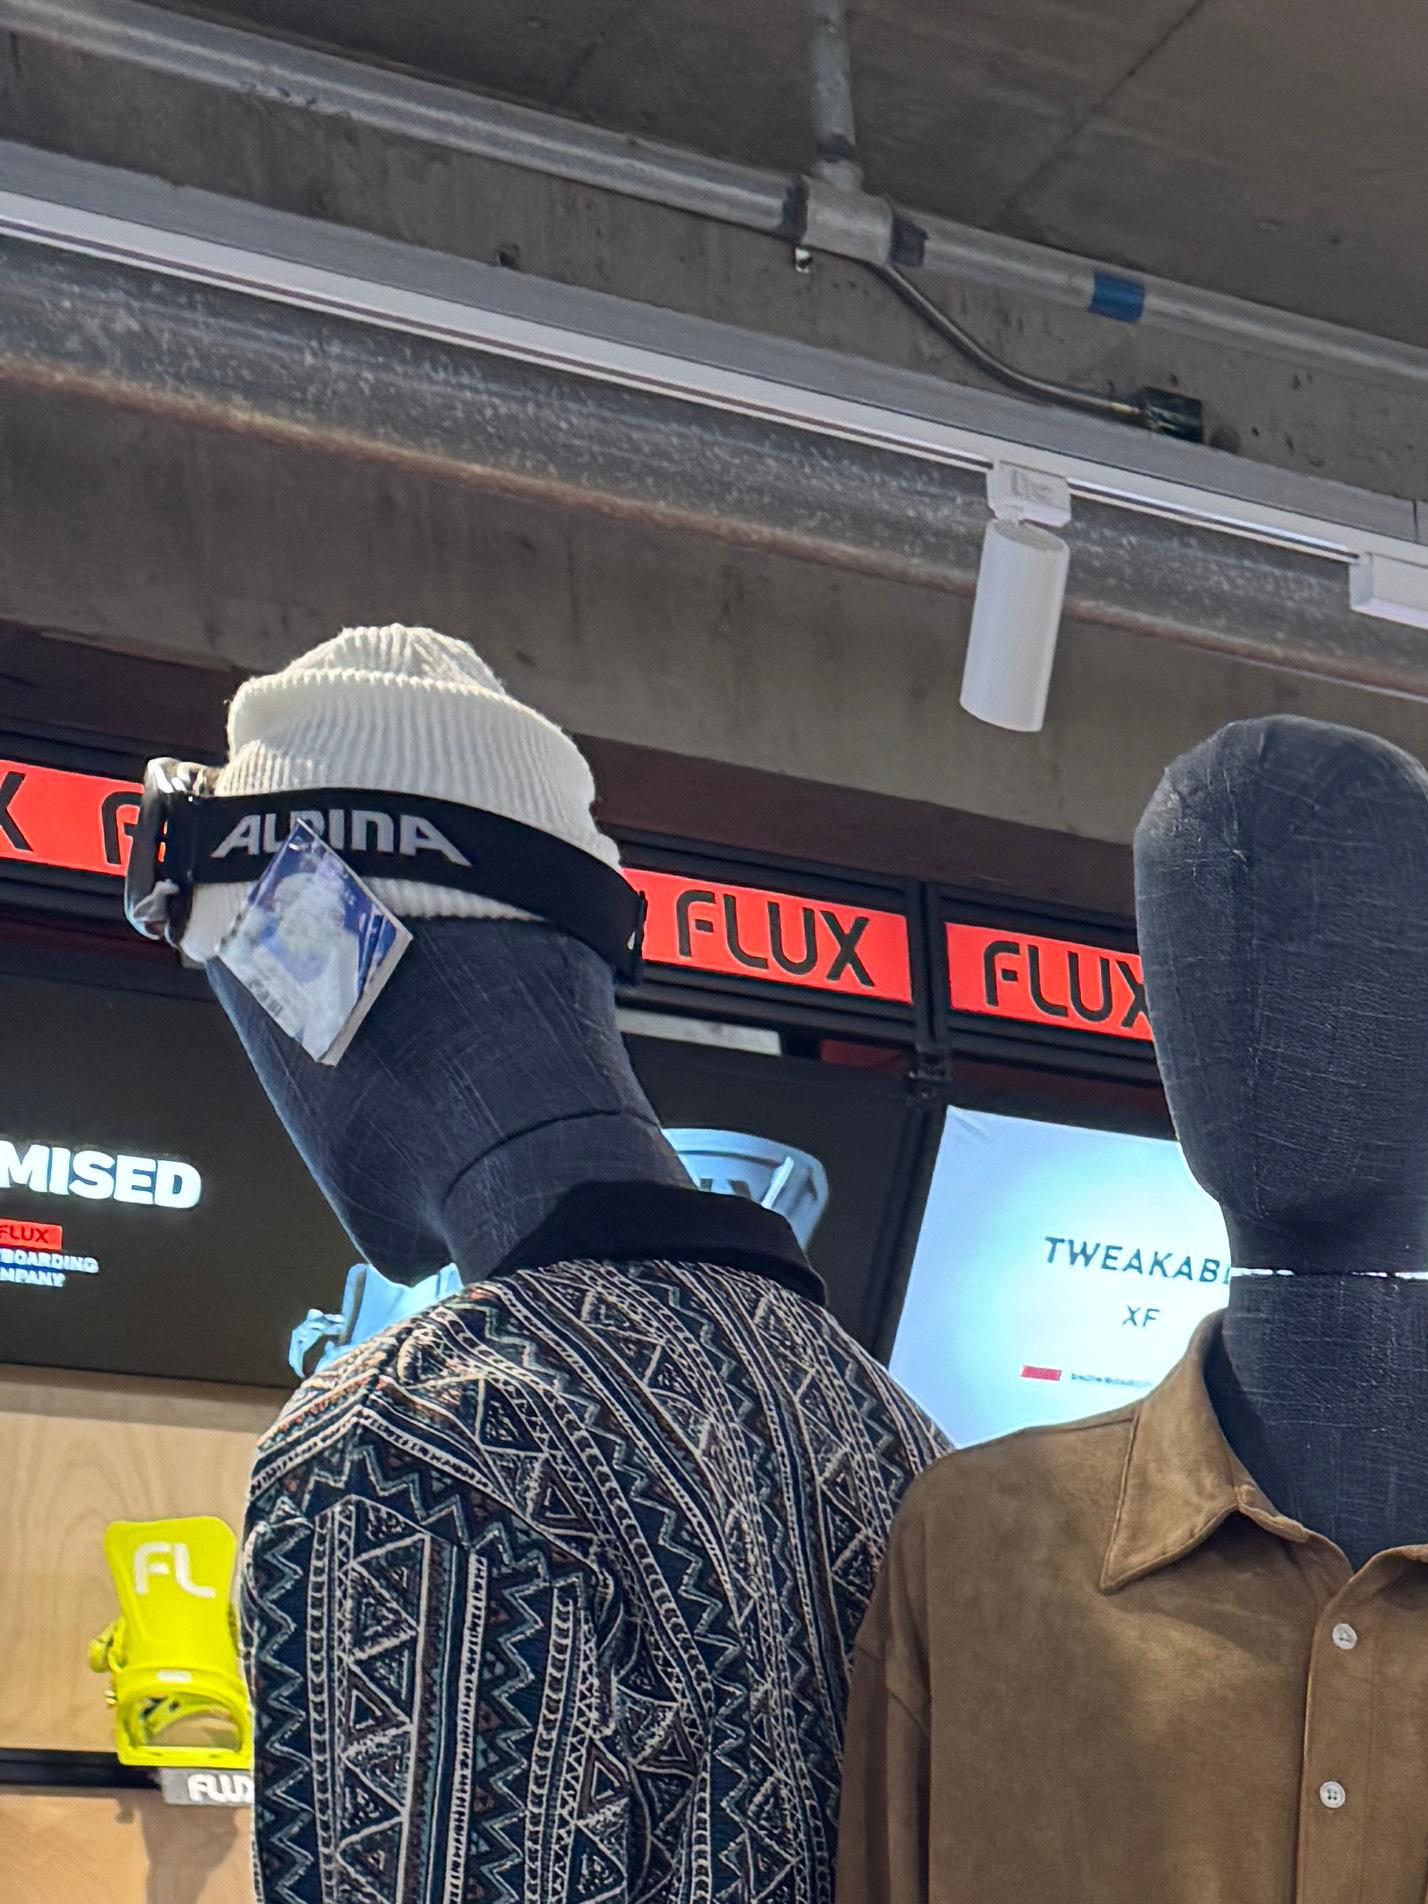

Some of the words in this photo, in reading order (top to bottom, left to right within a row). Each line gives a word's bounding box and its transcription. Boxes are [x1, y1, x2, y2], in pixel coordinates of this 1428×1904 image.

[211, 808, 473, 868] ALPINA
[678, 890, 874, 987] FLUX
[1122, 1305, 1160, 1327] XF
[134, 1542, 215, 1598] FL
